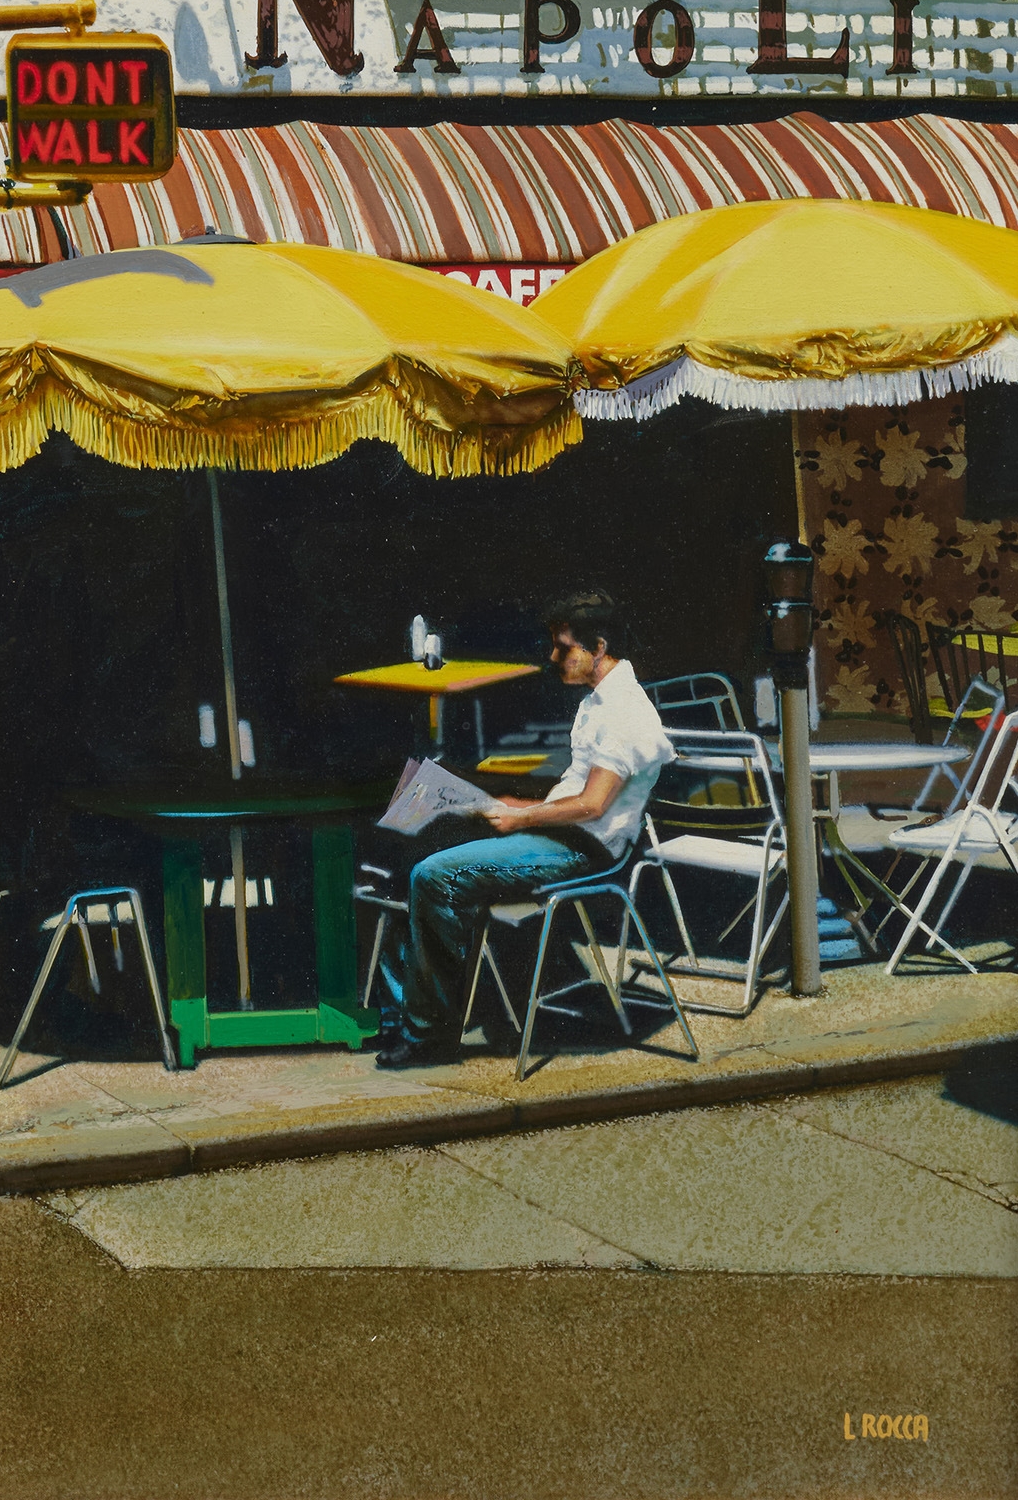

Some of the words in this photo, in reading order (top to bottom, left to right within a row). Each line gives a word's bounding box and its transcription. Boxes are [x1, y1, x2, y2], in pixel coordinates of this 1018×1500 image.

[17, 60, 149, 106] DONT
[17, 118, 150, 166] WALK
[844, 1412, 856, 1440] L
[861, 1413, 929, 1442] ROCCA
